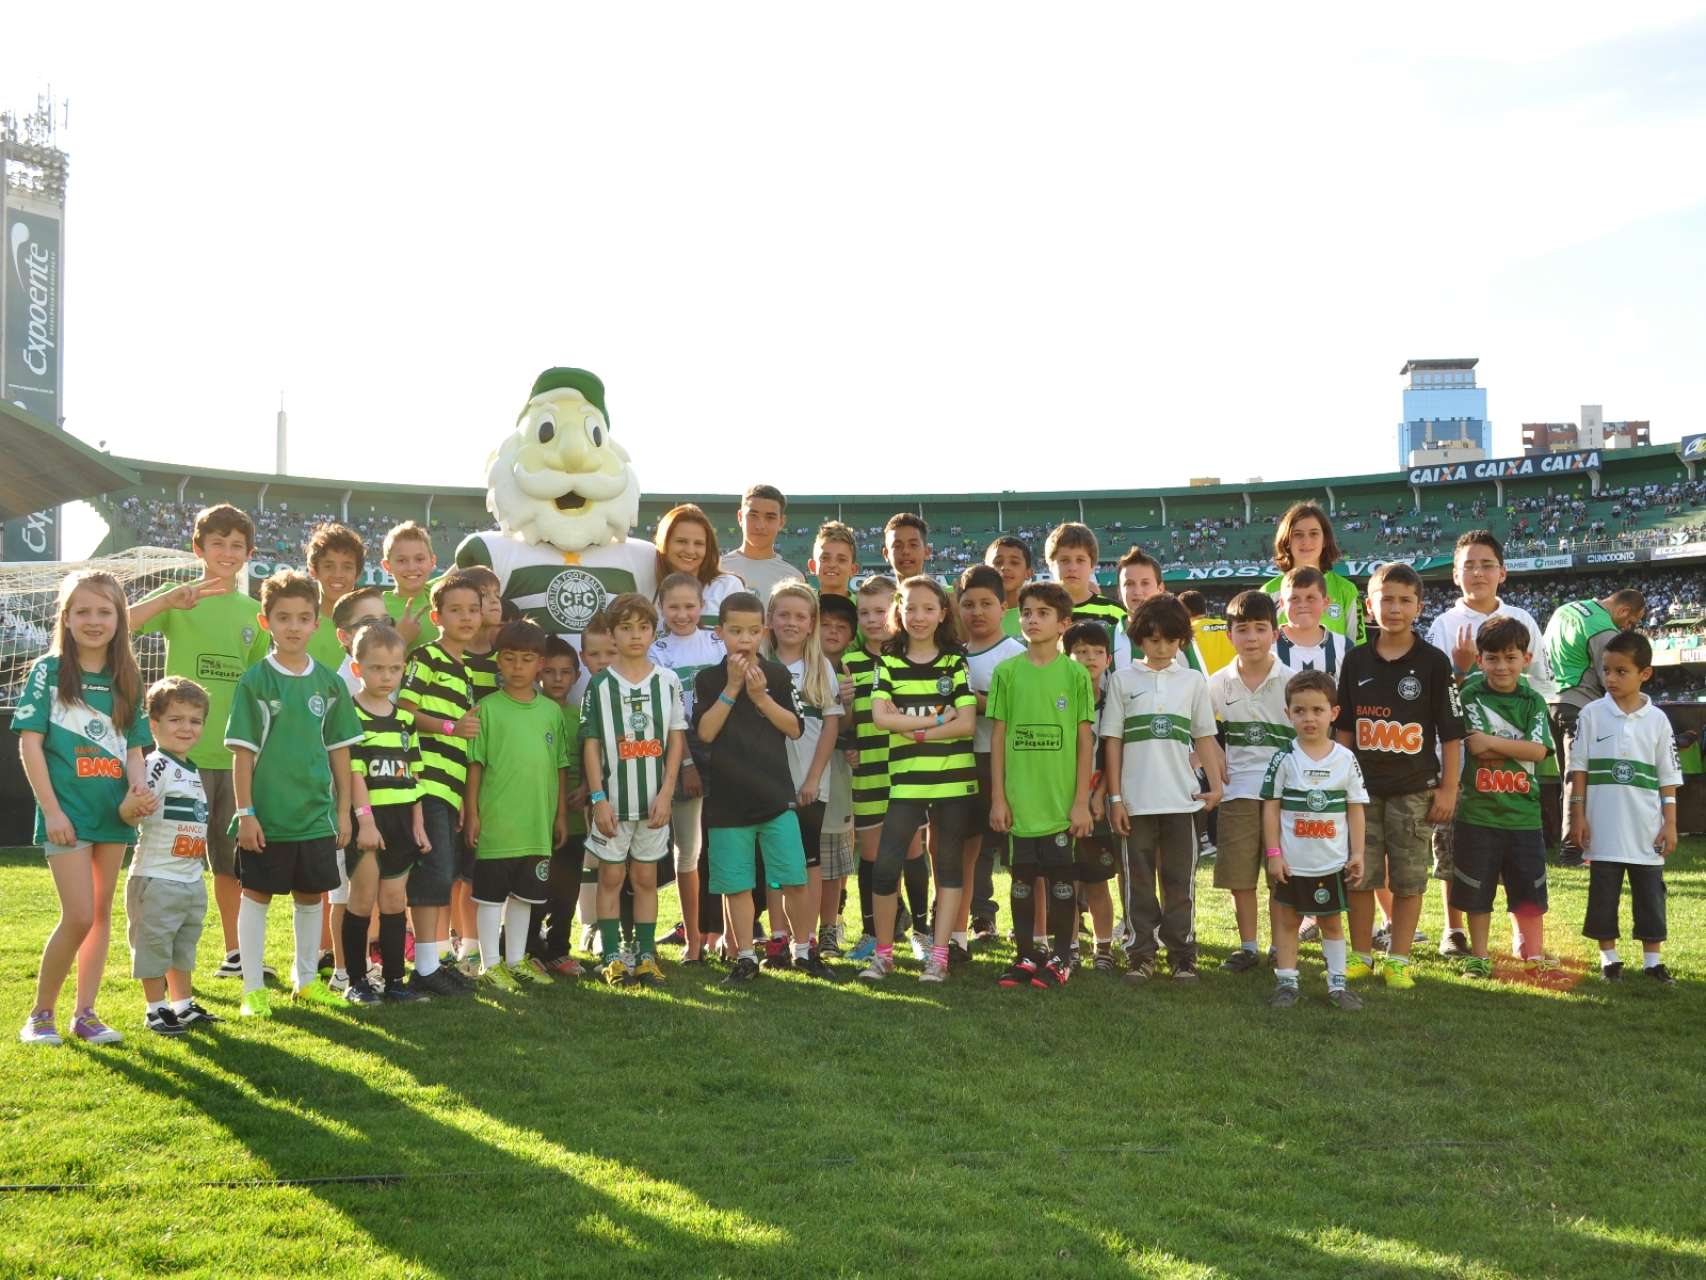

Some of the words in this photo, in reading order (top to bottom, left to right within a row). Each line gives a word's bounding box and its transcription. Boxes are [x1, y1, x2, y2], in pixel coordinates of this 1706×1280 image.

[23, 242, 55, 376] Expoente
[1410, 465, 1467, 484] CAIXA
[1474, 459, 1533, 478] CAIXA
[1541, 452, 1599, 472] CAIXA
[560, 592, 594, 607] CFC
[1356, 705, 1391, 717] BANCO
[1355, 718, 1424, 754] BMG
[619, 739, 663, 760] BMG
[75, 757, 122, 778] BMG
[1475, 768, 1530, 794] BMG
[1294, 819, 1336, 839] BMG
[172, 834, 207, 858] BM
